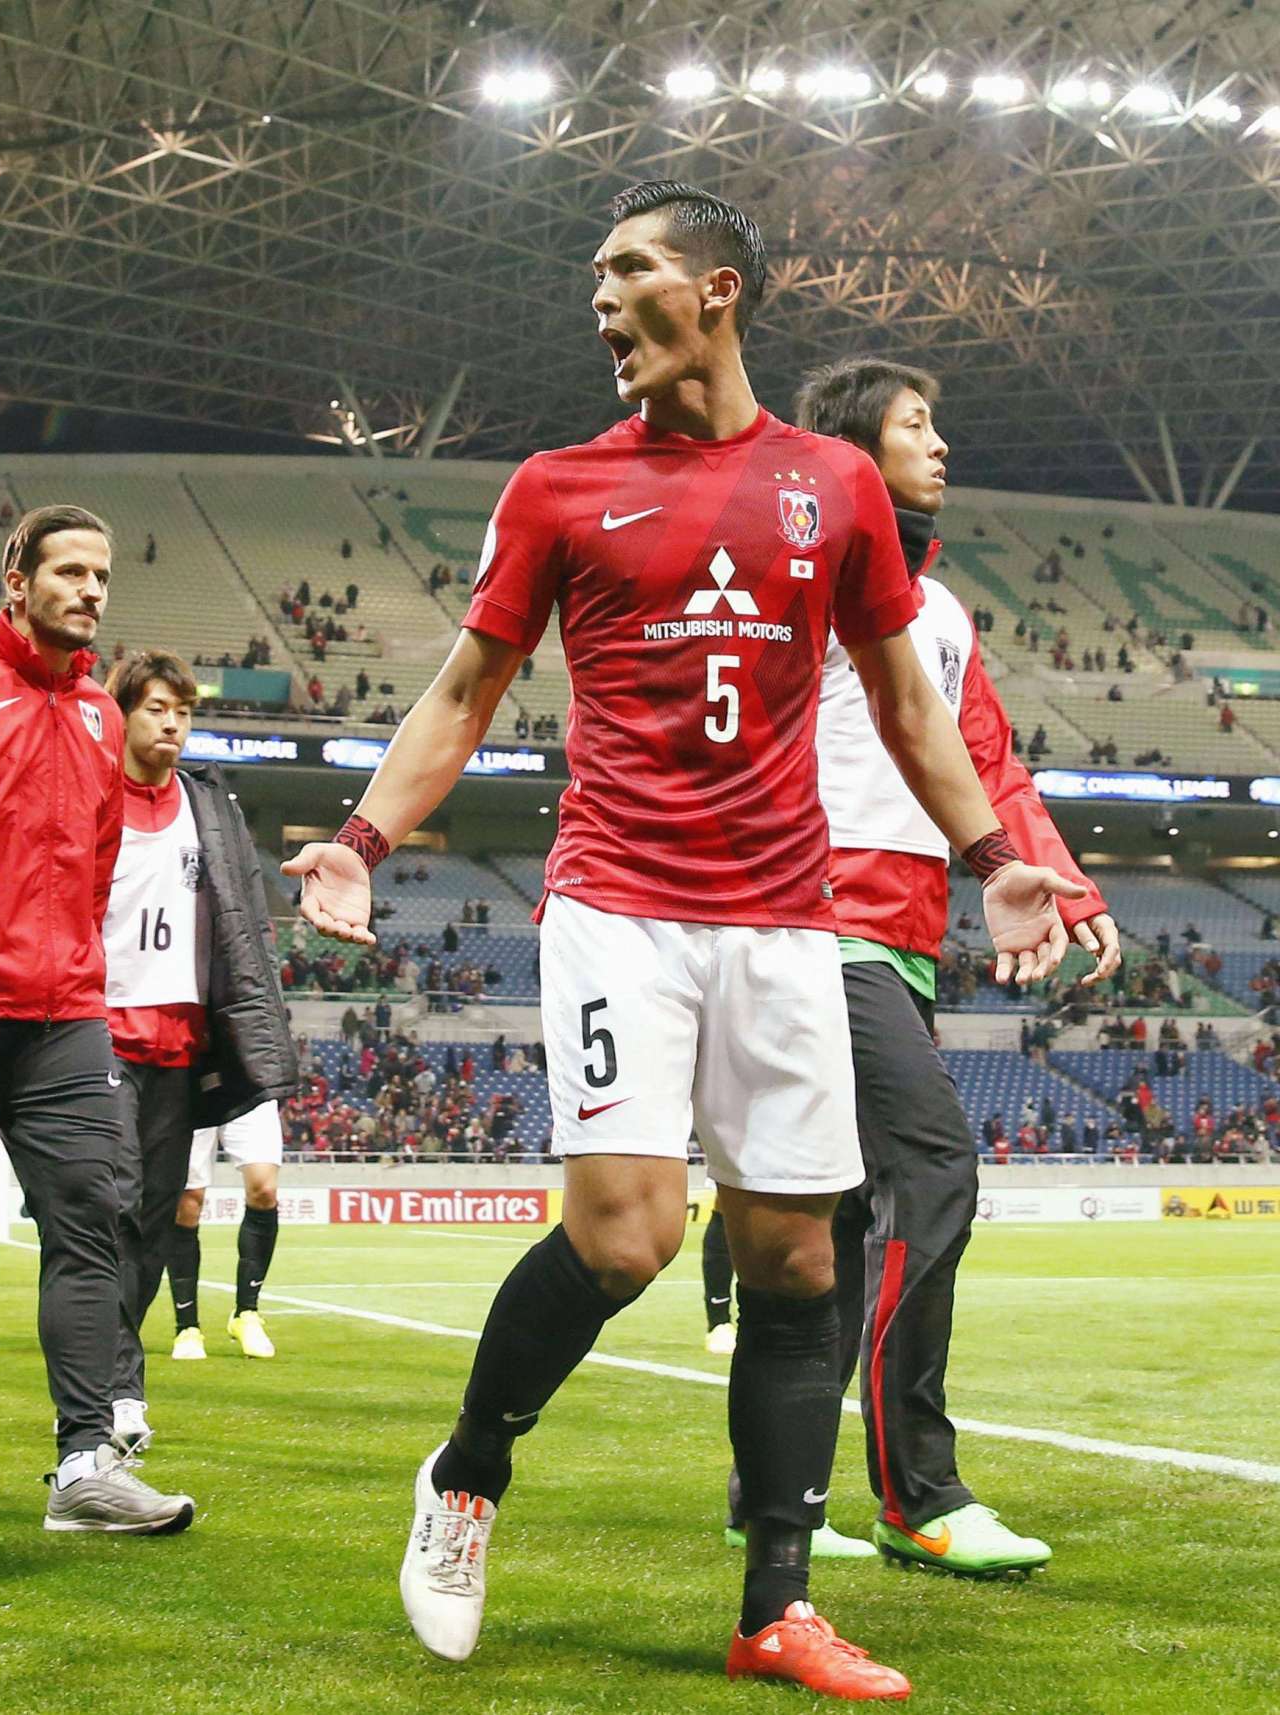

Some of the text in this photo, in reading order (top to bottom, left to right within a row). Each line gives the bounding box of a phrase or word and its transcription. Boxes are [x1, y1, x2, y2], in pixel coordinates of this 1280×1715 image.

[643, 619, 793, 643] MITSUBISHI MOTORS
[704, 654, 741, 743] 5
[232, 738, 298, 760] LEAGUE
[483, 752, 546, 771] LEAGUE
[1174, 780, 1230, 798] LEAGUE
[139, 907, 172, 951] 16
[581, 997, 618, 1088] 5
[339, 1190, 541, 1225] Fly Emirates
